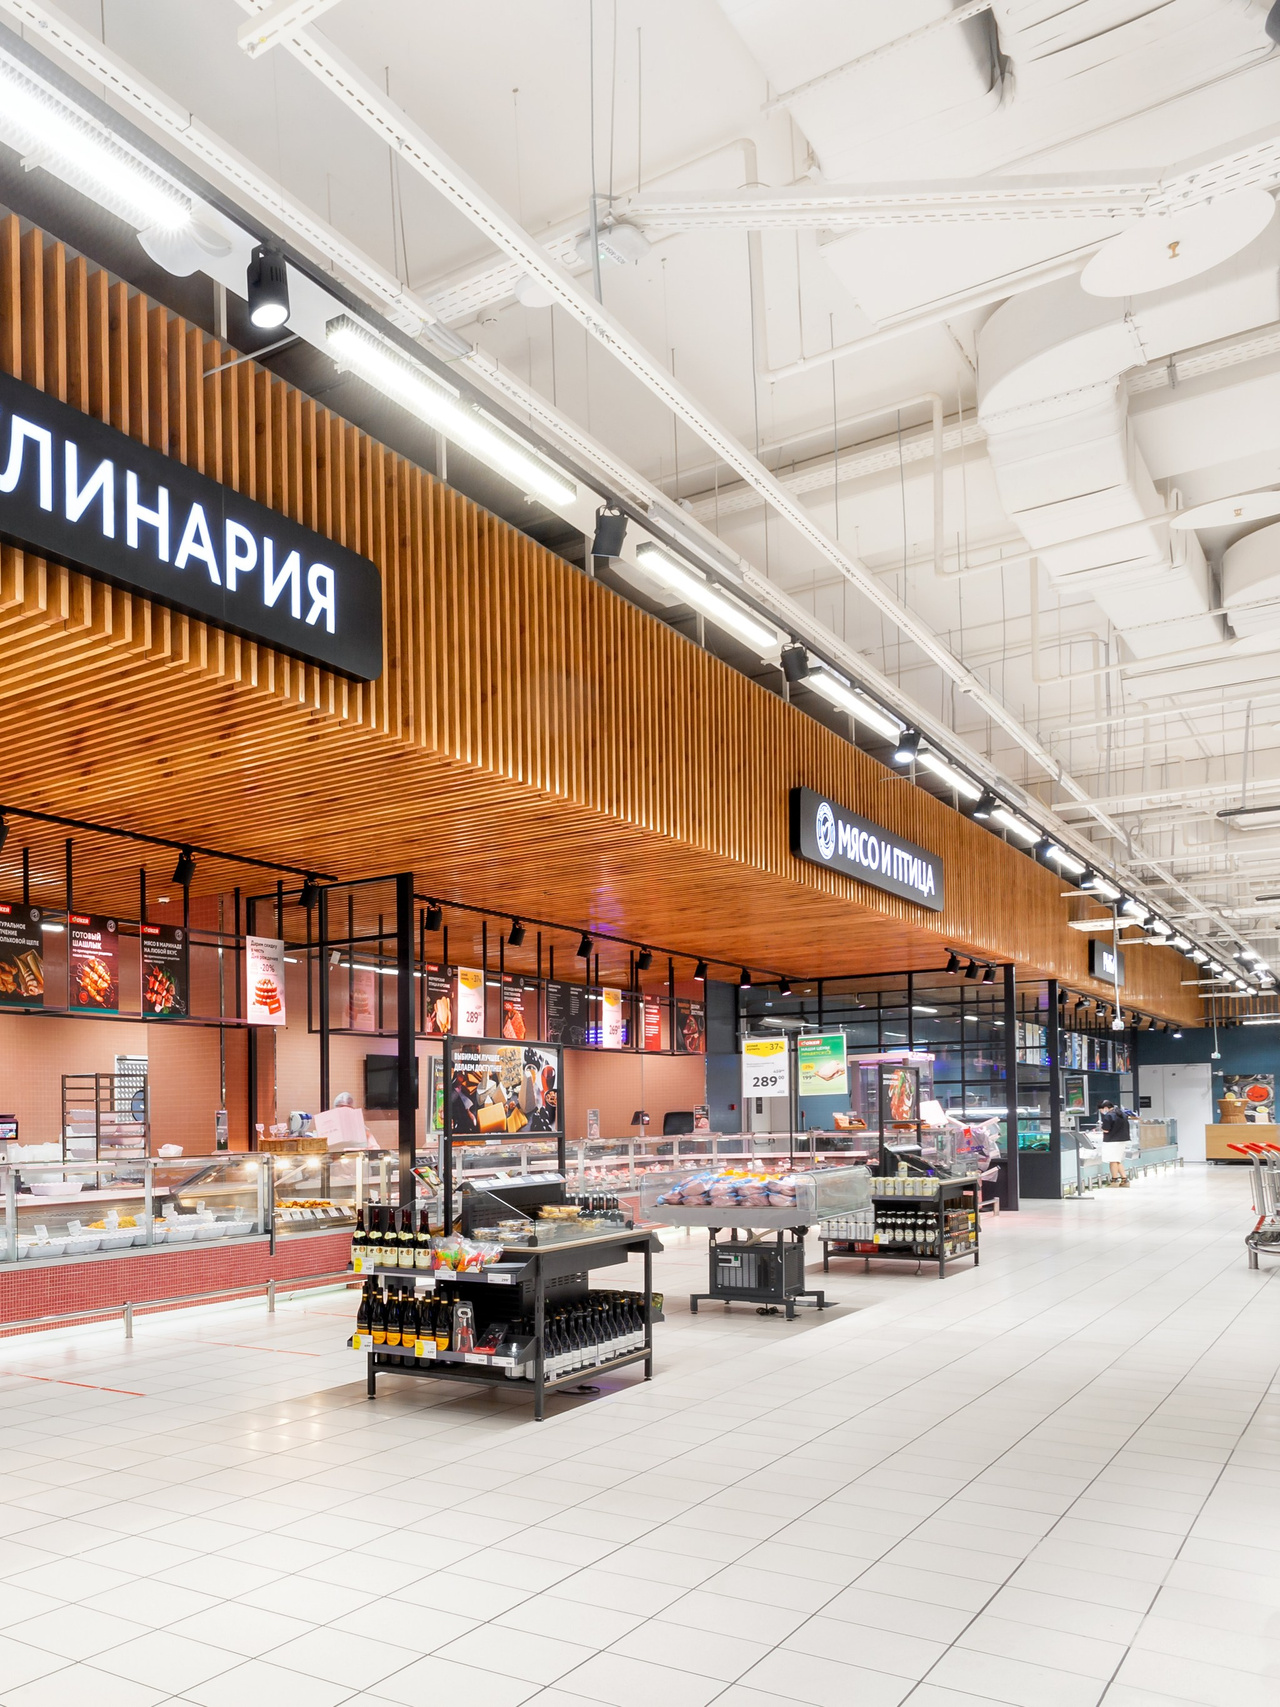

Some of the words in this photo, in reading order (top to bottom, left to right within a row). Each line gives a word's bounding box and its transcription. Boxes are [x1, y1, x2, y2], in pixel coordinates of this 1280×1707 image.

[838, 819, 879, 870] МЯСО
[881, 841, 892, 877] И
[893, 847, 936, 898] ПТИЦА
[72, 930, 102, 941] ГОТОВЫЙ
[72, 940, 102, 950] ШАШЛЫК
[752, 1075, 778, 1087] 289
